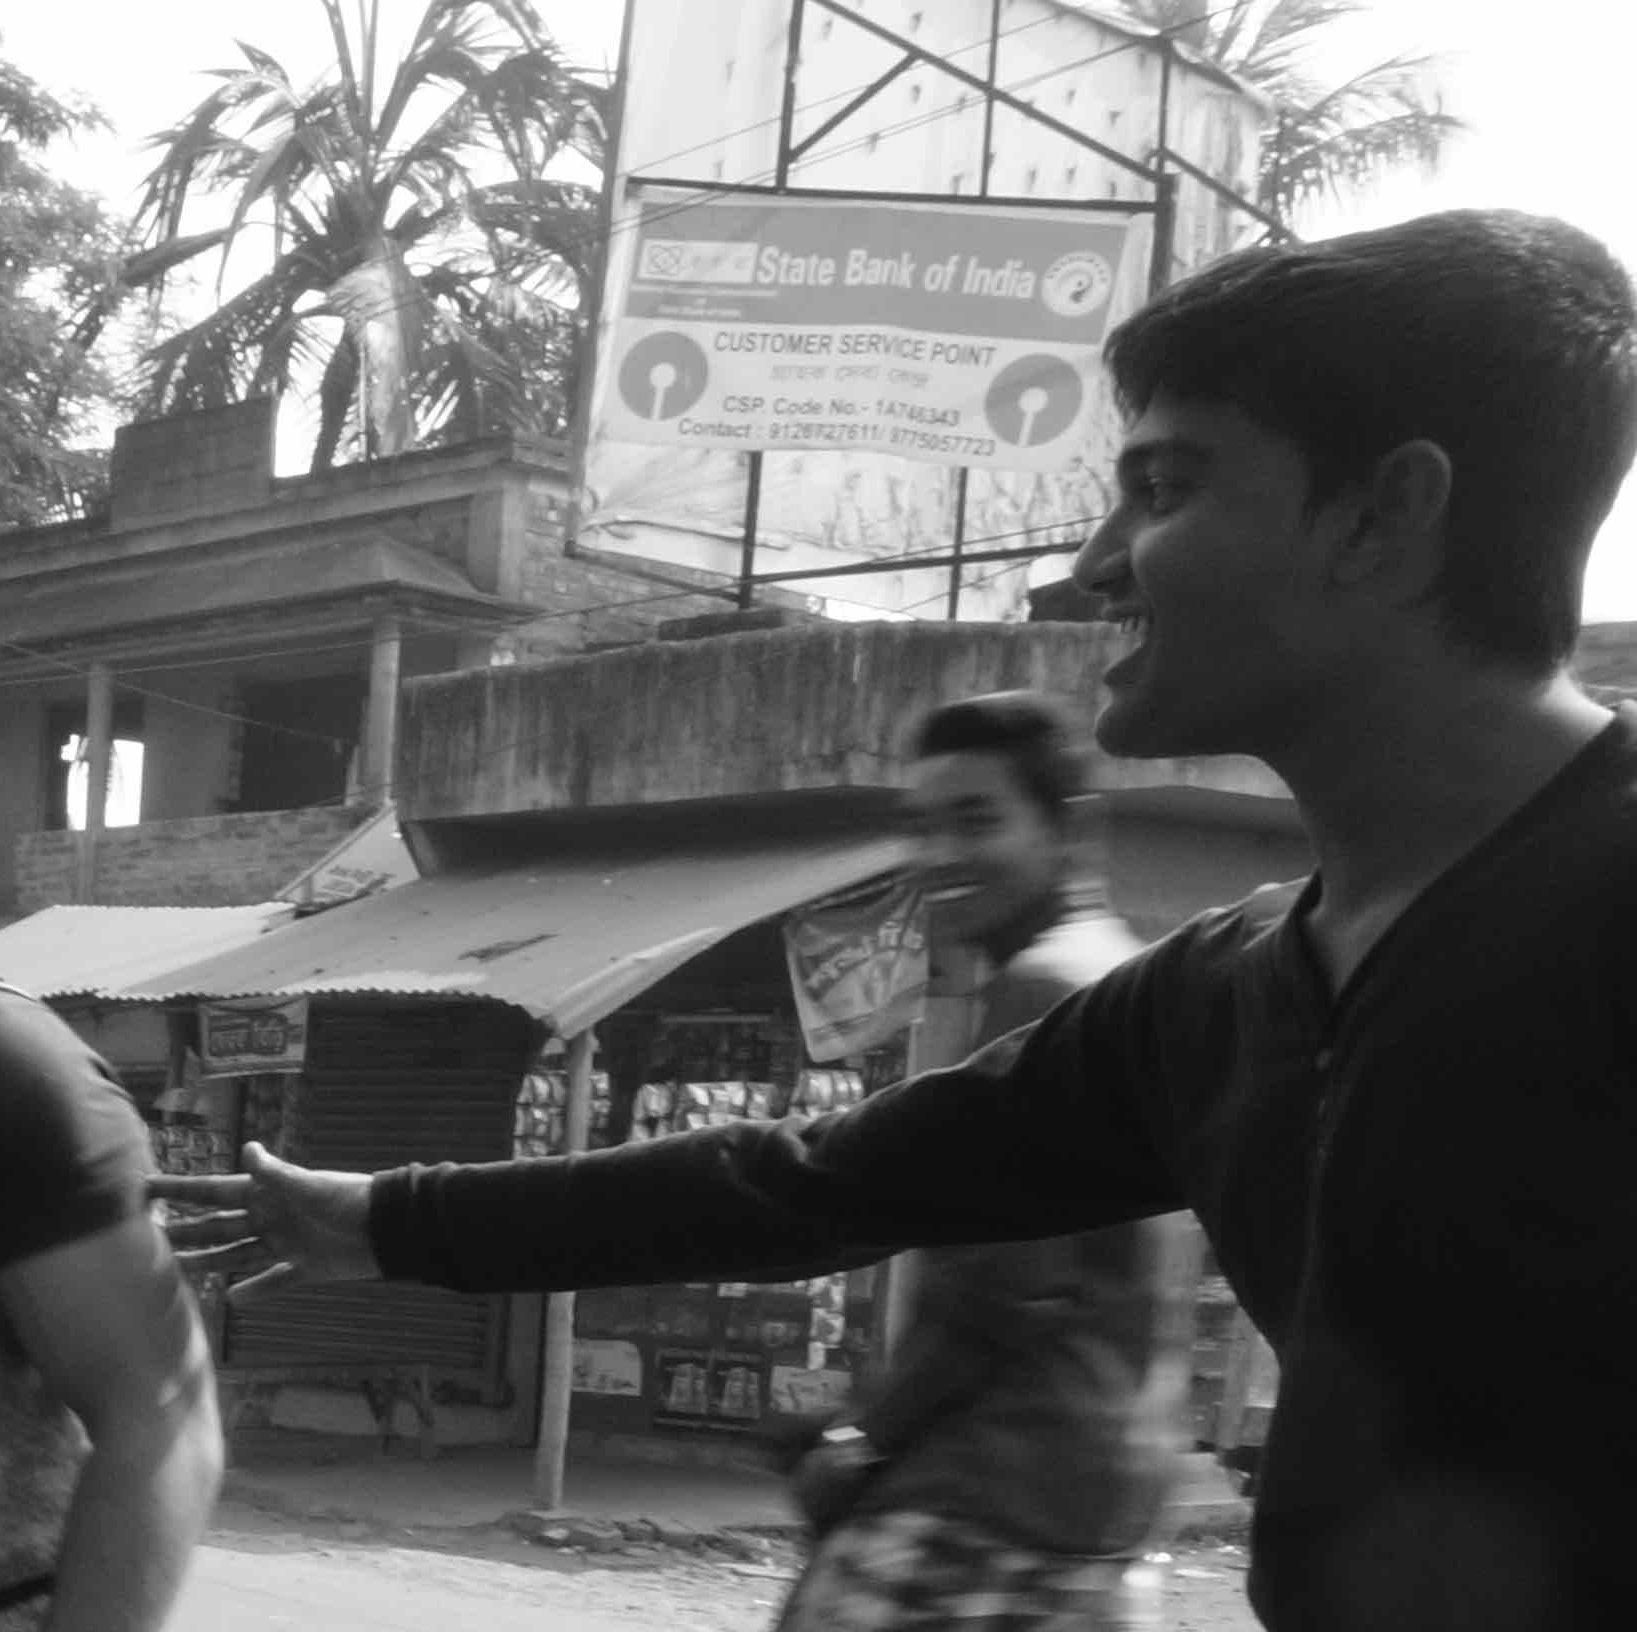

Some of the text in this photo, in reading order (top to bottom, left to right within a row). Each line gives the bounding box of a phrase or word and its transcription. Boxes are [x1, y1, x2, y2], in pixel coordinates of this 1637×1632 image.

[757, 246, 1037, 299] State Bank of India
[714, 331, 998, 368] CUSTOMER SERVICE POINT
[773, 398, 823, 415] Code
[678, 417, 753, 438] Contact
